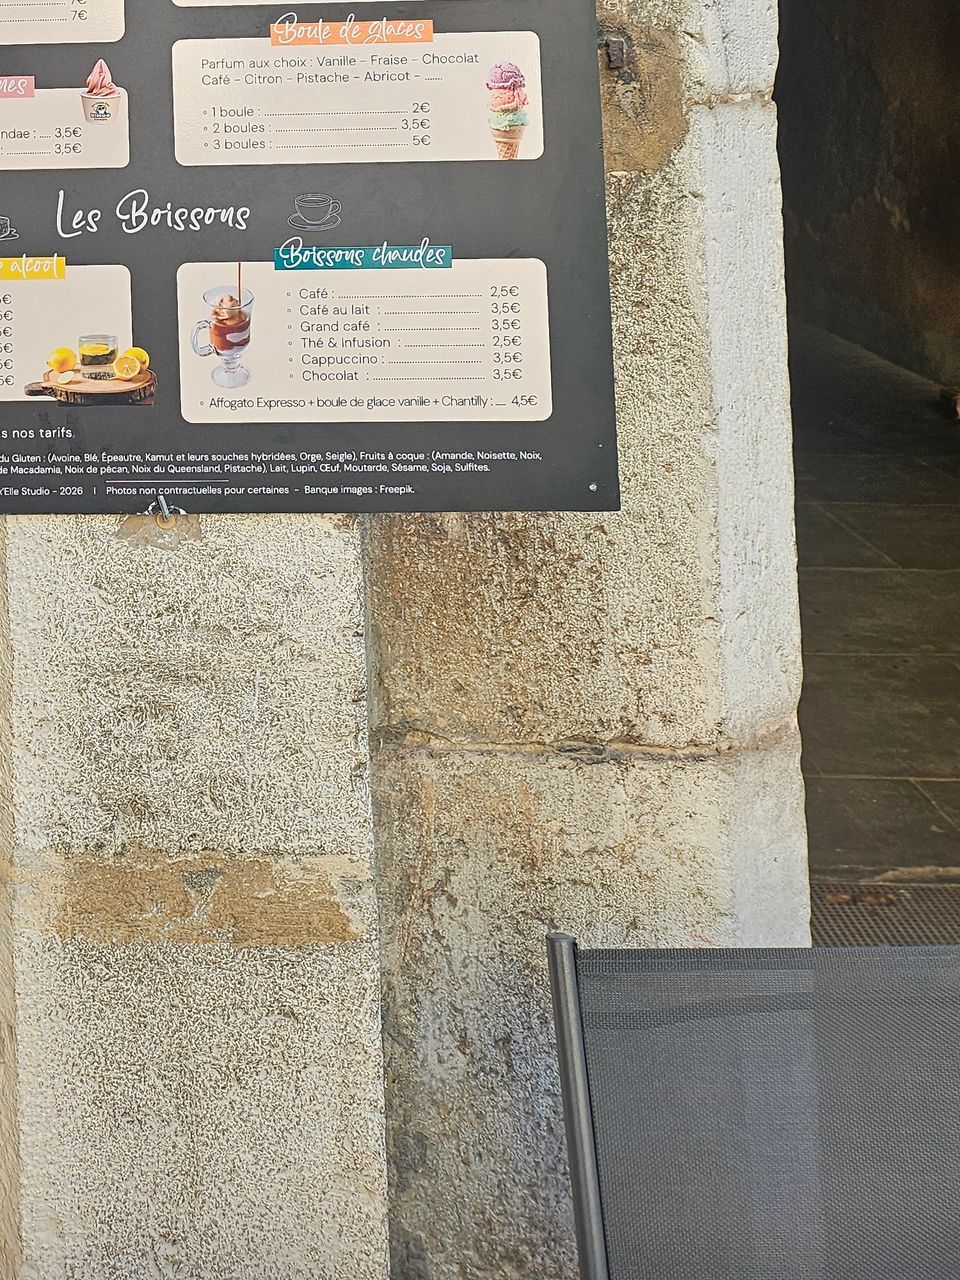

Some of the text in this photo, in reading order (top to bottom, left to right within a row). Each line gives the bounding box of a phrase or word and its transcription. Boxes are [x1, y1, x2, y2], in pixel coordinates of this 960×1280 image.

[274, 12, 424, 44] Boule de glaces
[56, 188, 250, 239] Les Boissons
[279, 237, 447, 269] Boissons chaudes
[10, 253, 58, 279] alcool
[301, 352, 522, 367] Cappuccino 3,5€
[12, 430, 34, 439] nos
[344, 463, 389, 473] Moutarde,
[21, 486, 50, 496] Studio
[60, 486, 83, 496] 2026
